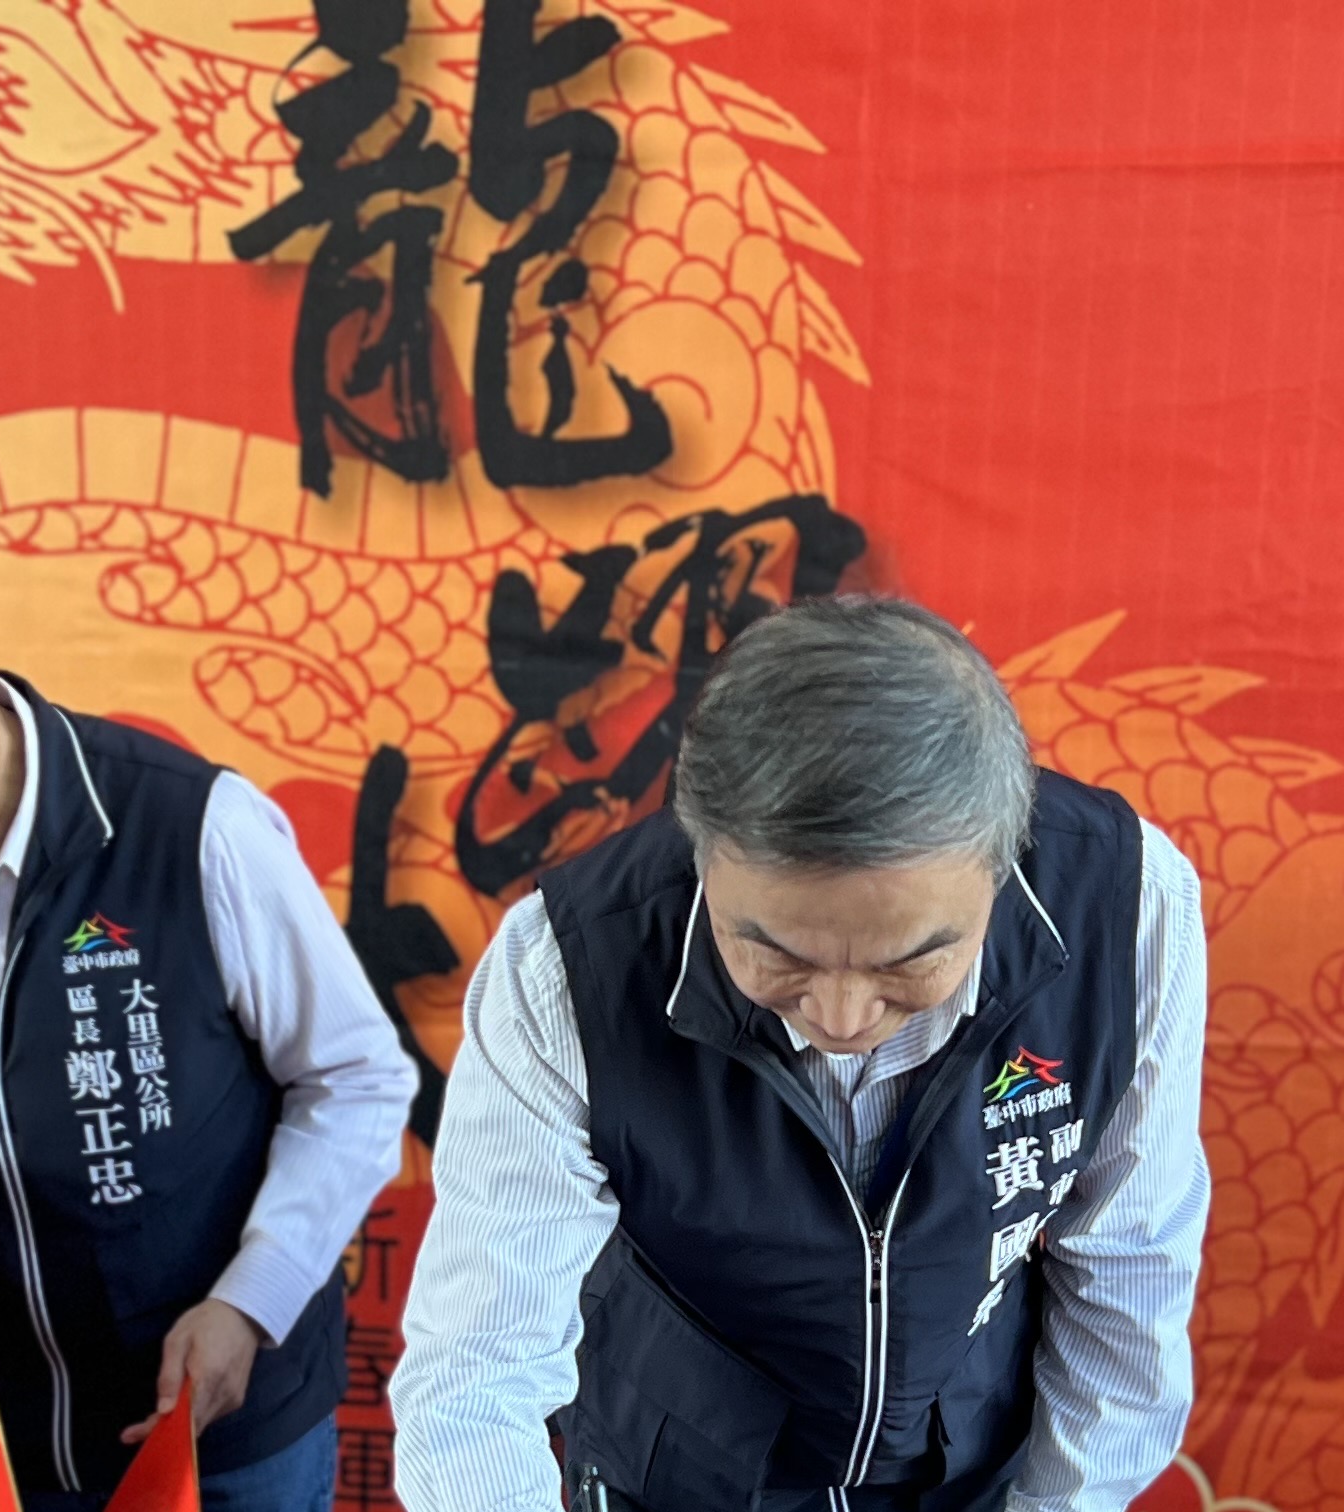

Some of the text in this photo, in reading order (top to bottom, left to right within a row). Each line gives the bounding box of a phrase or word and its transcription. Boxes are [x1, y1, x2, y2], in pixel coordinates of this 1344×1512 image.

[62, 947, 140, 974] 臺中市政府
[120, 978, 172, 1135] 大里區公所
[982, 1082, 1072, 1130] 臺中市政府
